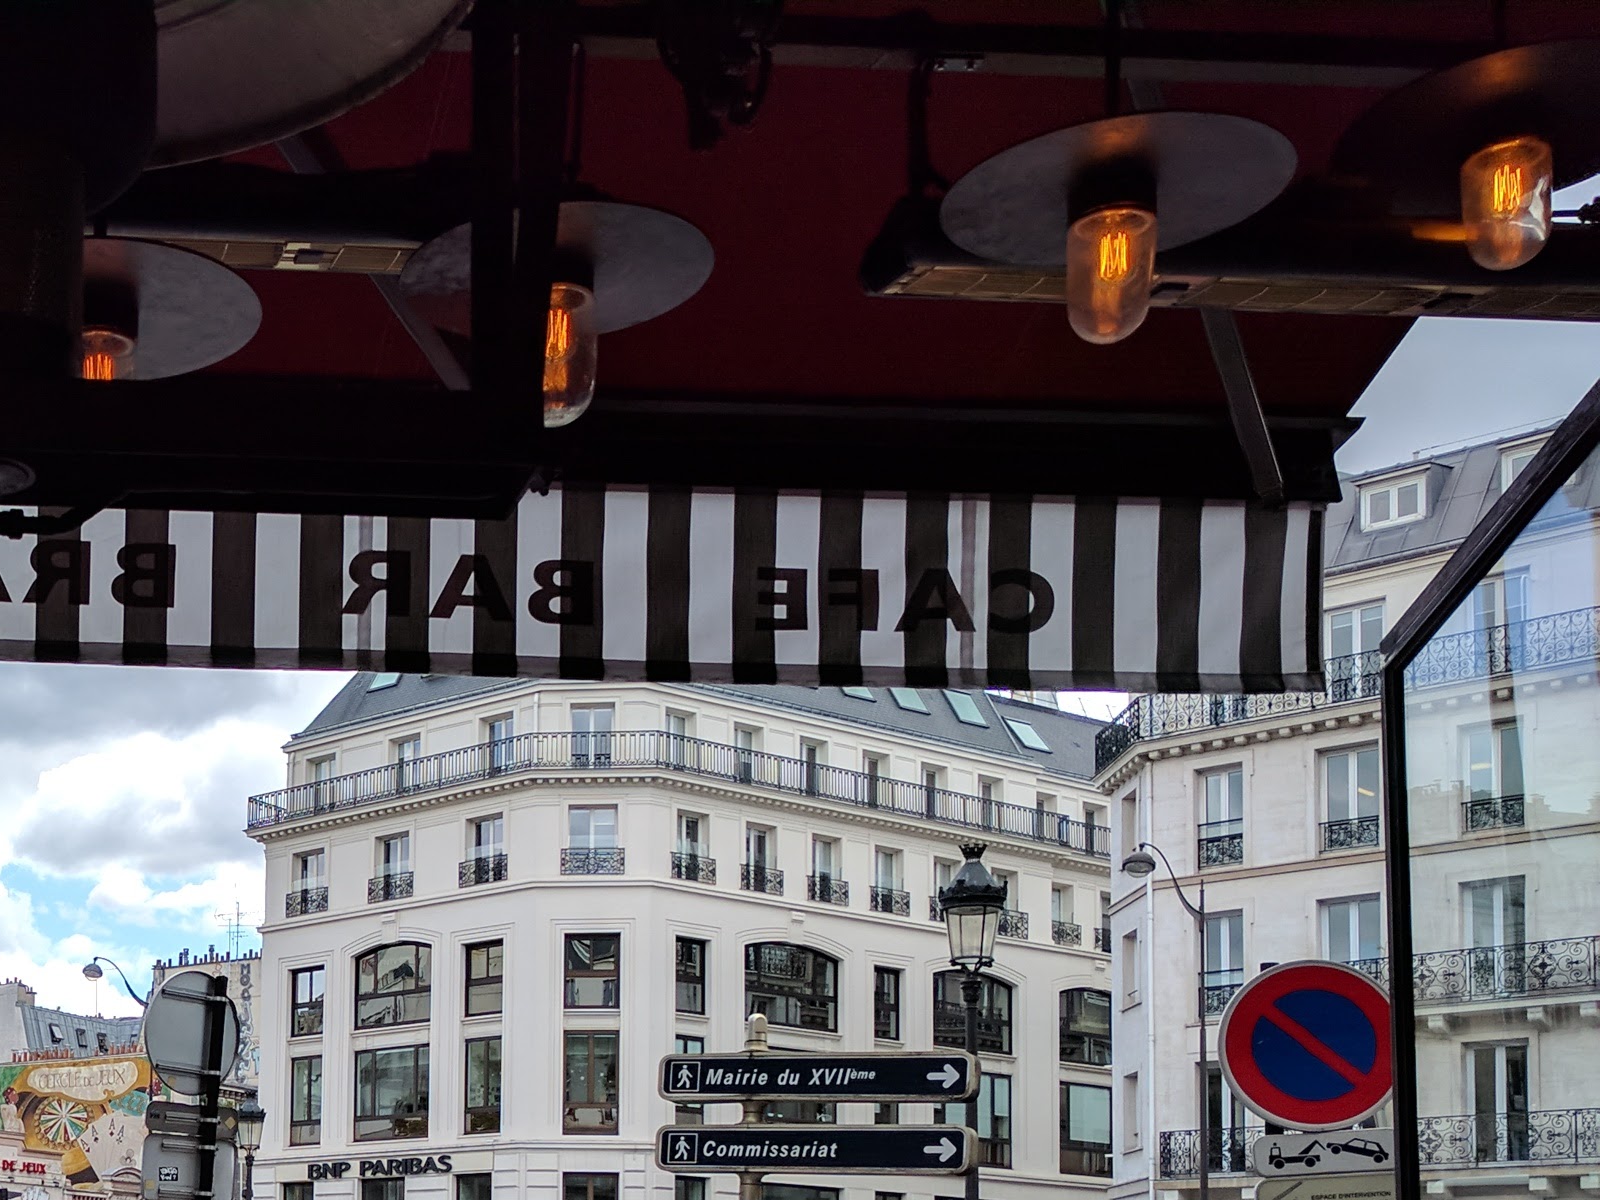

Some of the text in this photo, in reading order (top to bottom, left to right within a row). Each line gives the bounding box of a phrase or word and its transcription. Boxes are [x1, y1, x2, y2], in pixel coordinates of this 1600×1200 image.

[705, 1068, 768, 1086] Mairie
[777, 1069, 800, 1086] du
[702, 1140, 838, 1159] Commissariat
[2, 1159, 18, 1172] DE
[20, 1161, 47, 1174] JEUX
[307, 1155, 453, 1180] BNP PARIBAS
[1311, 1193, 1337, 1200] ESPACE
